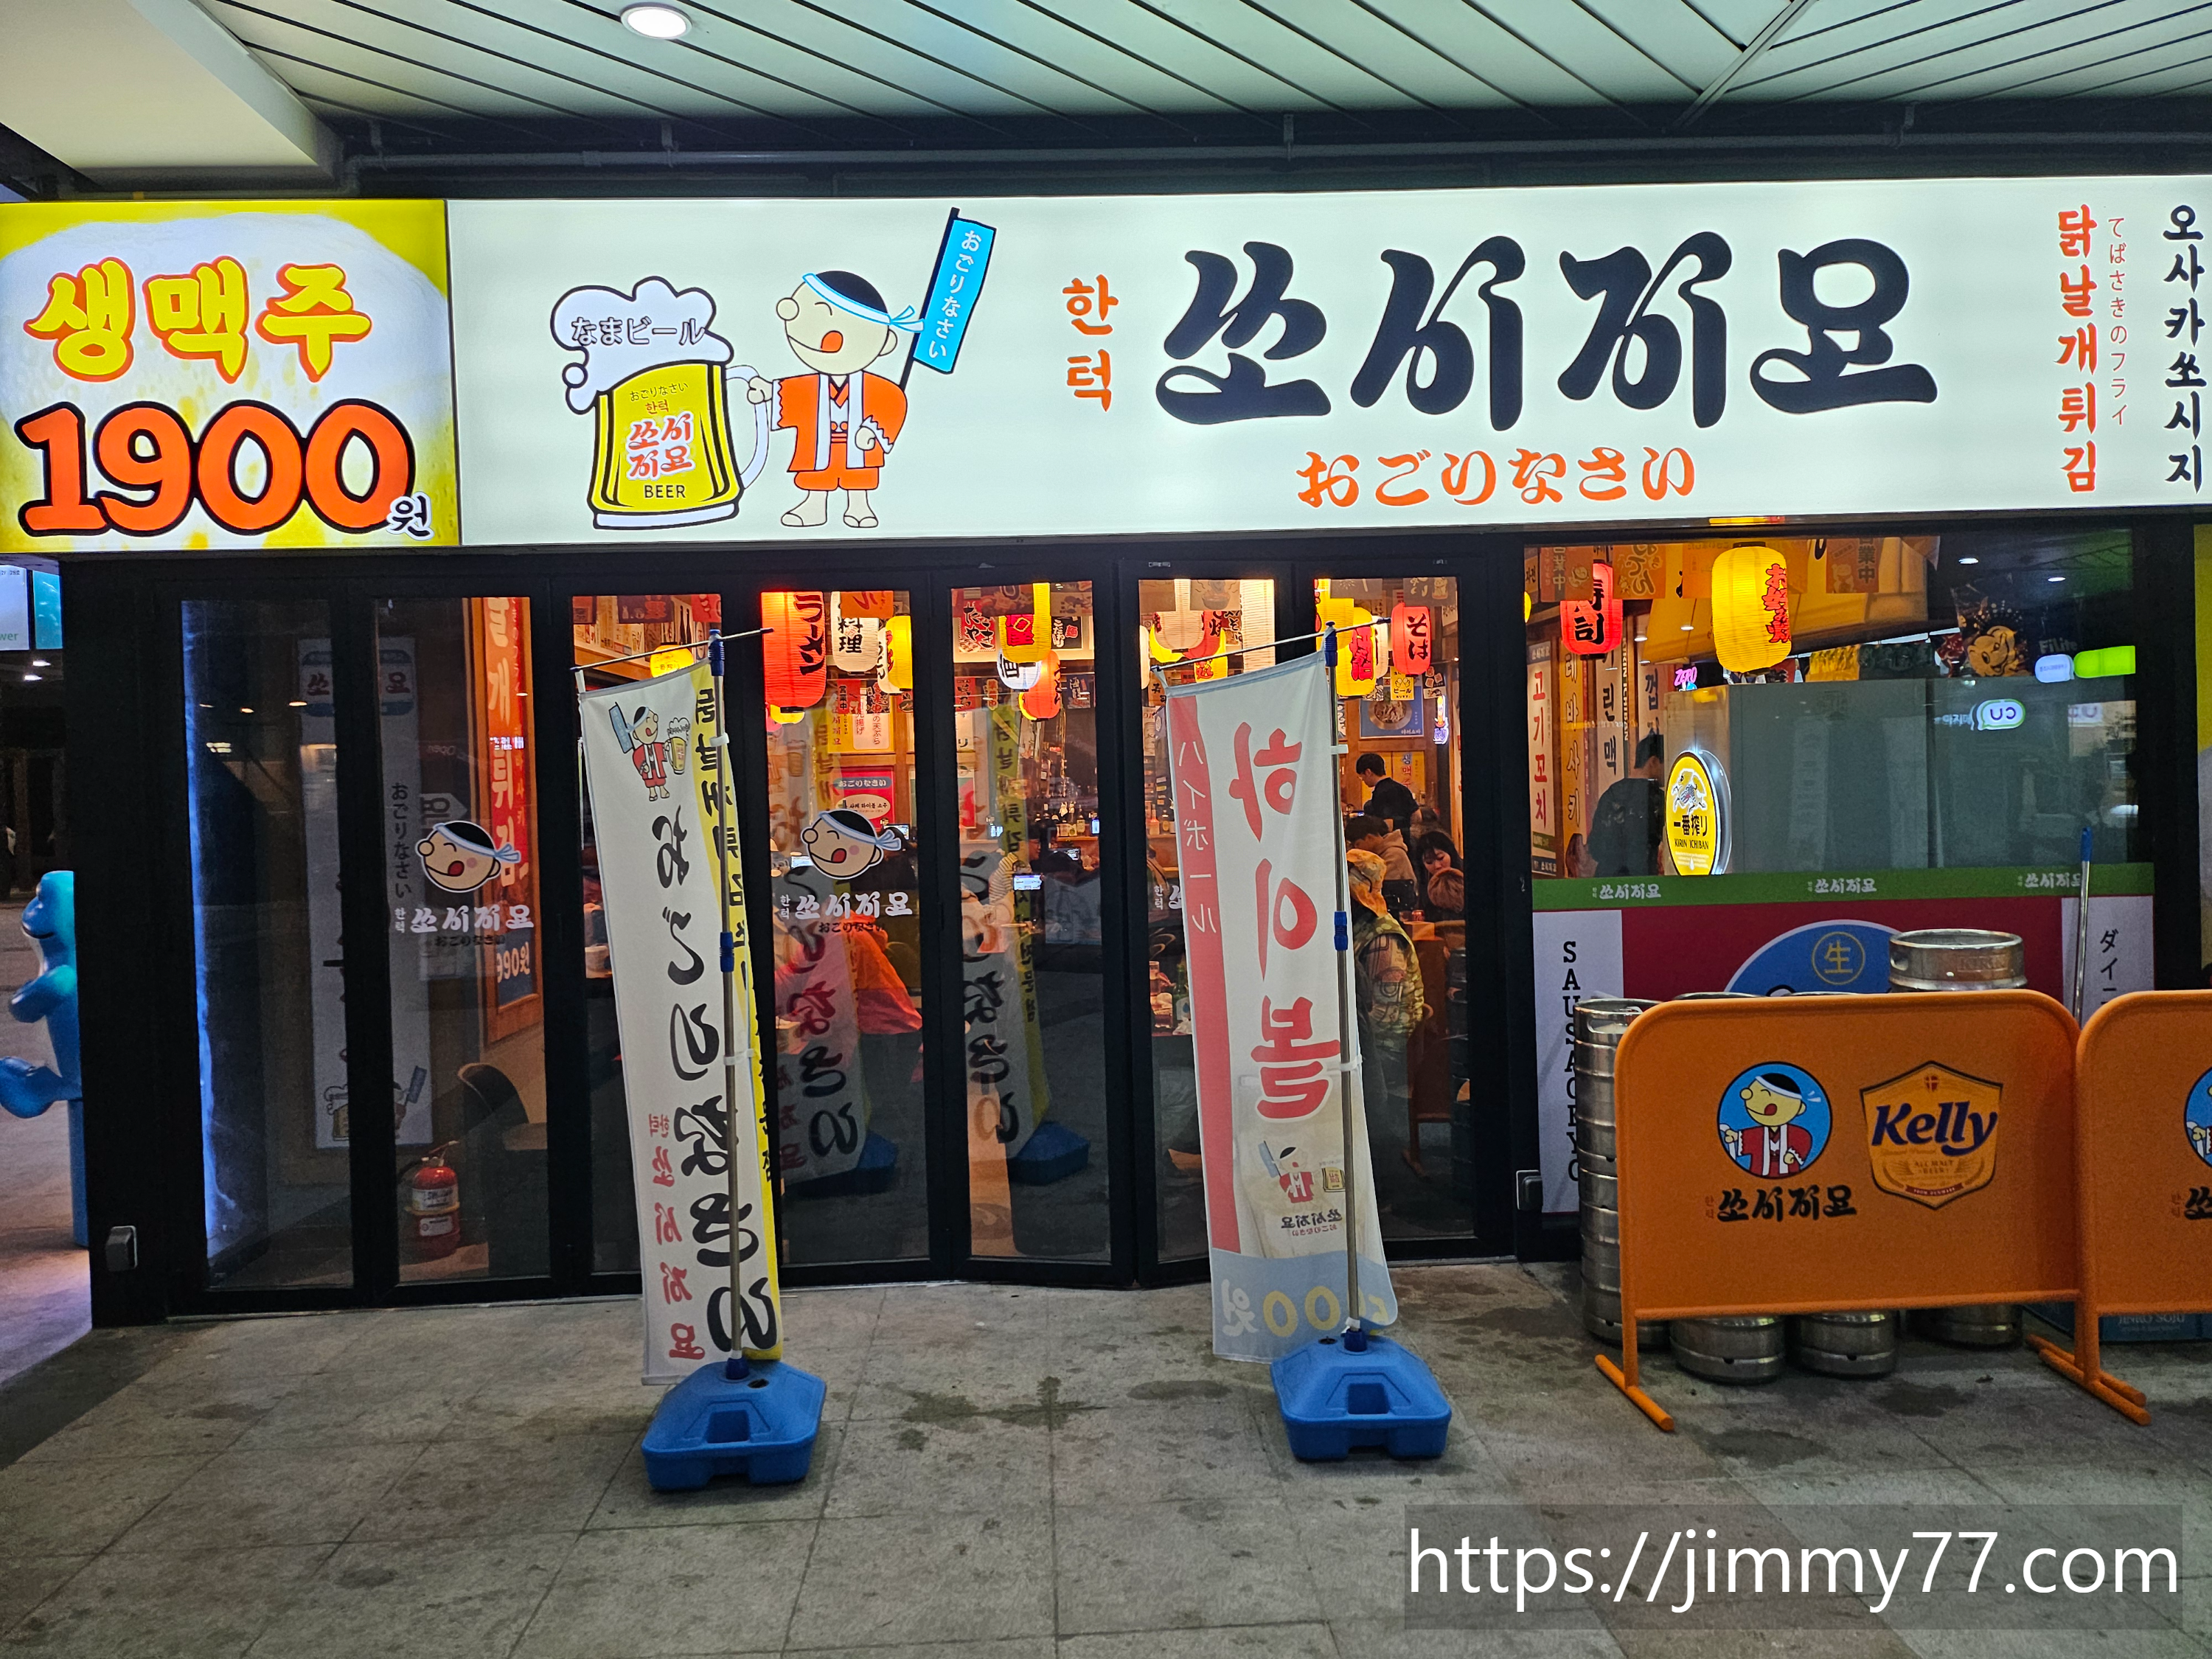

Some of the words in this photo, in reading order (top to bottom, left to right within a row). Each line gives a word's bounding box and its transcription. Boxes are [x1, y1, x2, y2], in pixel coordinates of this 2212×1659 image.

[24, 257, 372, 383] 생맥주
[928, 229, 981, 359] おごりなさい
[2107, 218, 2127, 425] てばさきのフライ
[571, 316, 709, 347] なまビール
[1062, 274, 1119, 413] 한턱
[1155, 231, 1938, 431] 쏘시지요
[2054, 204, 2097, 493] 닭날개튀김
[2163, 205, 2207, 494] 오사카쏘시지
[629, 382, 689, 402] おごりなさい
[645, 399, 669, 414] 한턱
[644, 484, 686, 498] BEER
[1298, 444, 1696, 509] おごりなさい
[1674, 666, 1698, 687] ZERO
[1532, 671, 1548, 829] 고기꼬치
[392, 782, 413, 899] おごりなさい
[1673, 814, 1708, 837] 一番搾り
[1674, 838, 1688, 848] KIRIN
[1689, 839, 1709, 849] ICHIBAN
[1823, 939, 1854, 975] 生
[1871, 1101, 1998, 1157] Kelly
